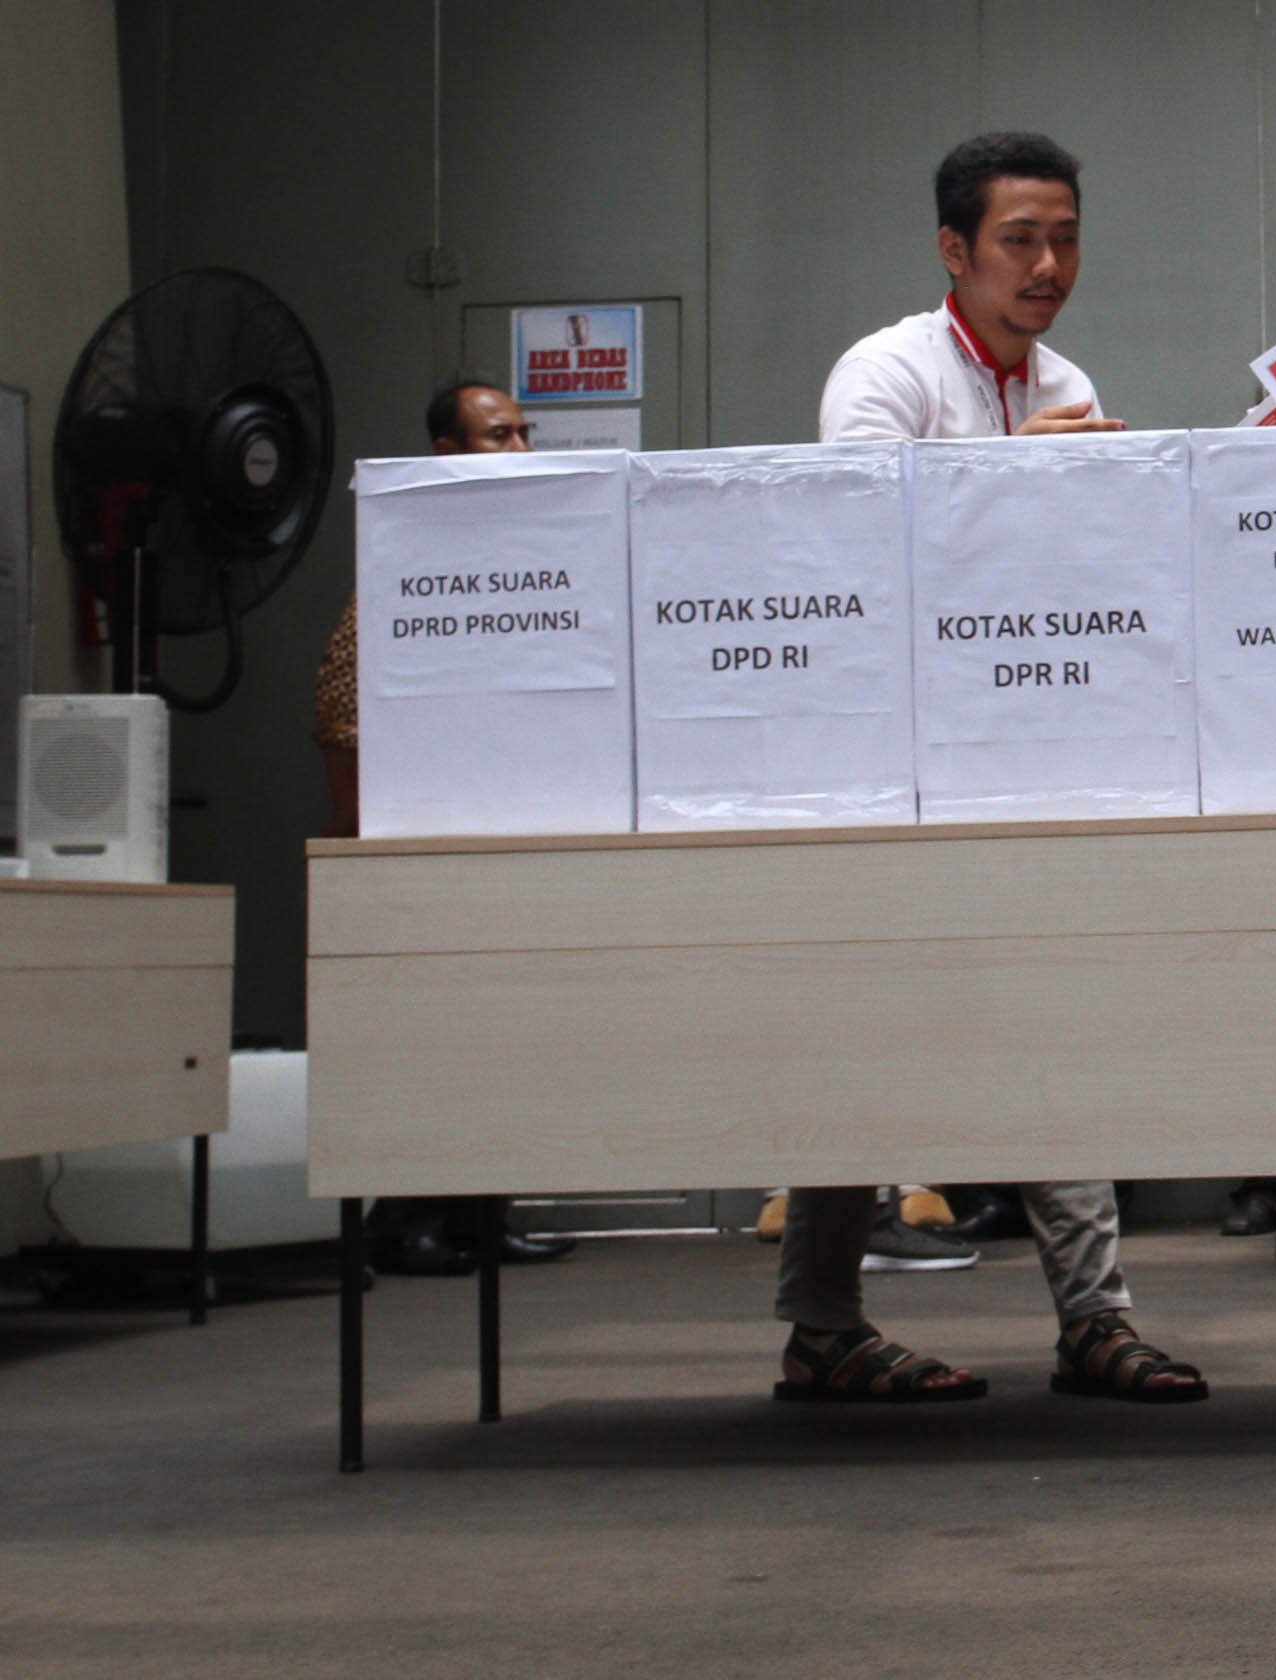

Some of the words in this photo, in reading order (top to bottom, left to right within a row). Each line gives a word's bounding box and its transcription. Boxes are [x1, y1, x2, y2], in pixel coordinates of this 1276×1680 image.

[400, 574, 481, 597] KOTAK
[488, 571, 570, 593] SUARA
[657, 599, 754, 625] KOTAK
[763, 595, 864, 621] SUARA
[393, 616, 458, 639] DPRD
[466, 611, 580, 635] PROVINSI
[938, 613, 1036, 641] KOTAK
[1045, 610, 1147, 637] SUARA
[712, 647, 772, 671] DPD
[782, 645, 808, 669] RI
[994, 663, 1053, 688] DPR
[1063, 661, 1090, 685] RI
